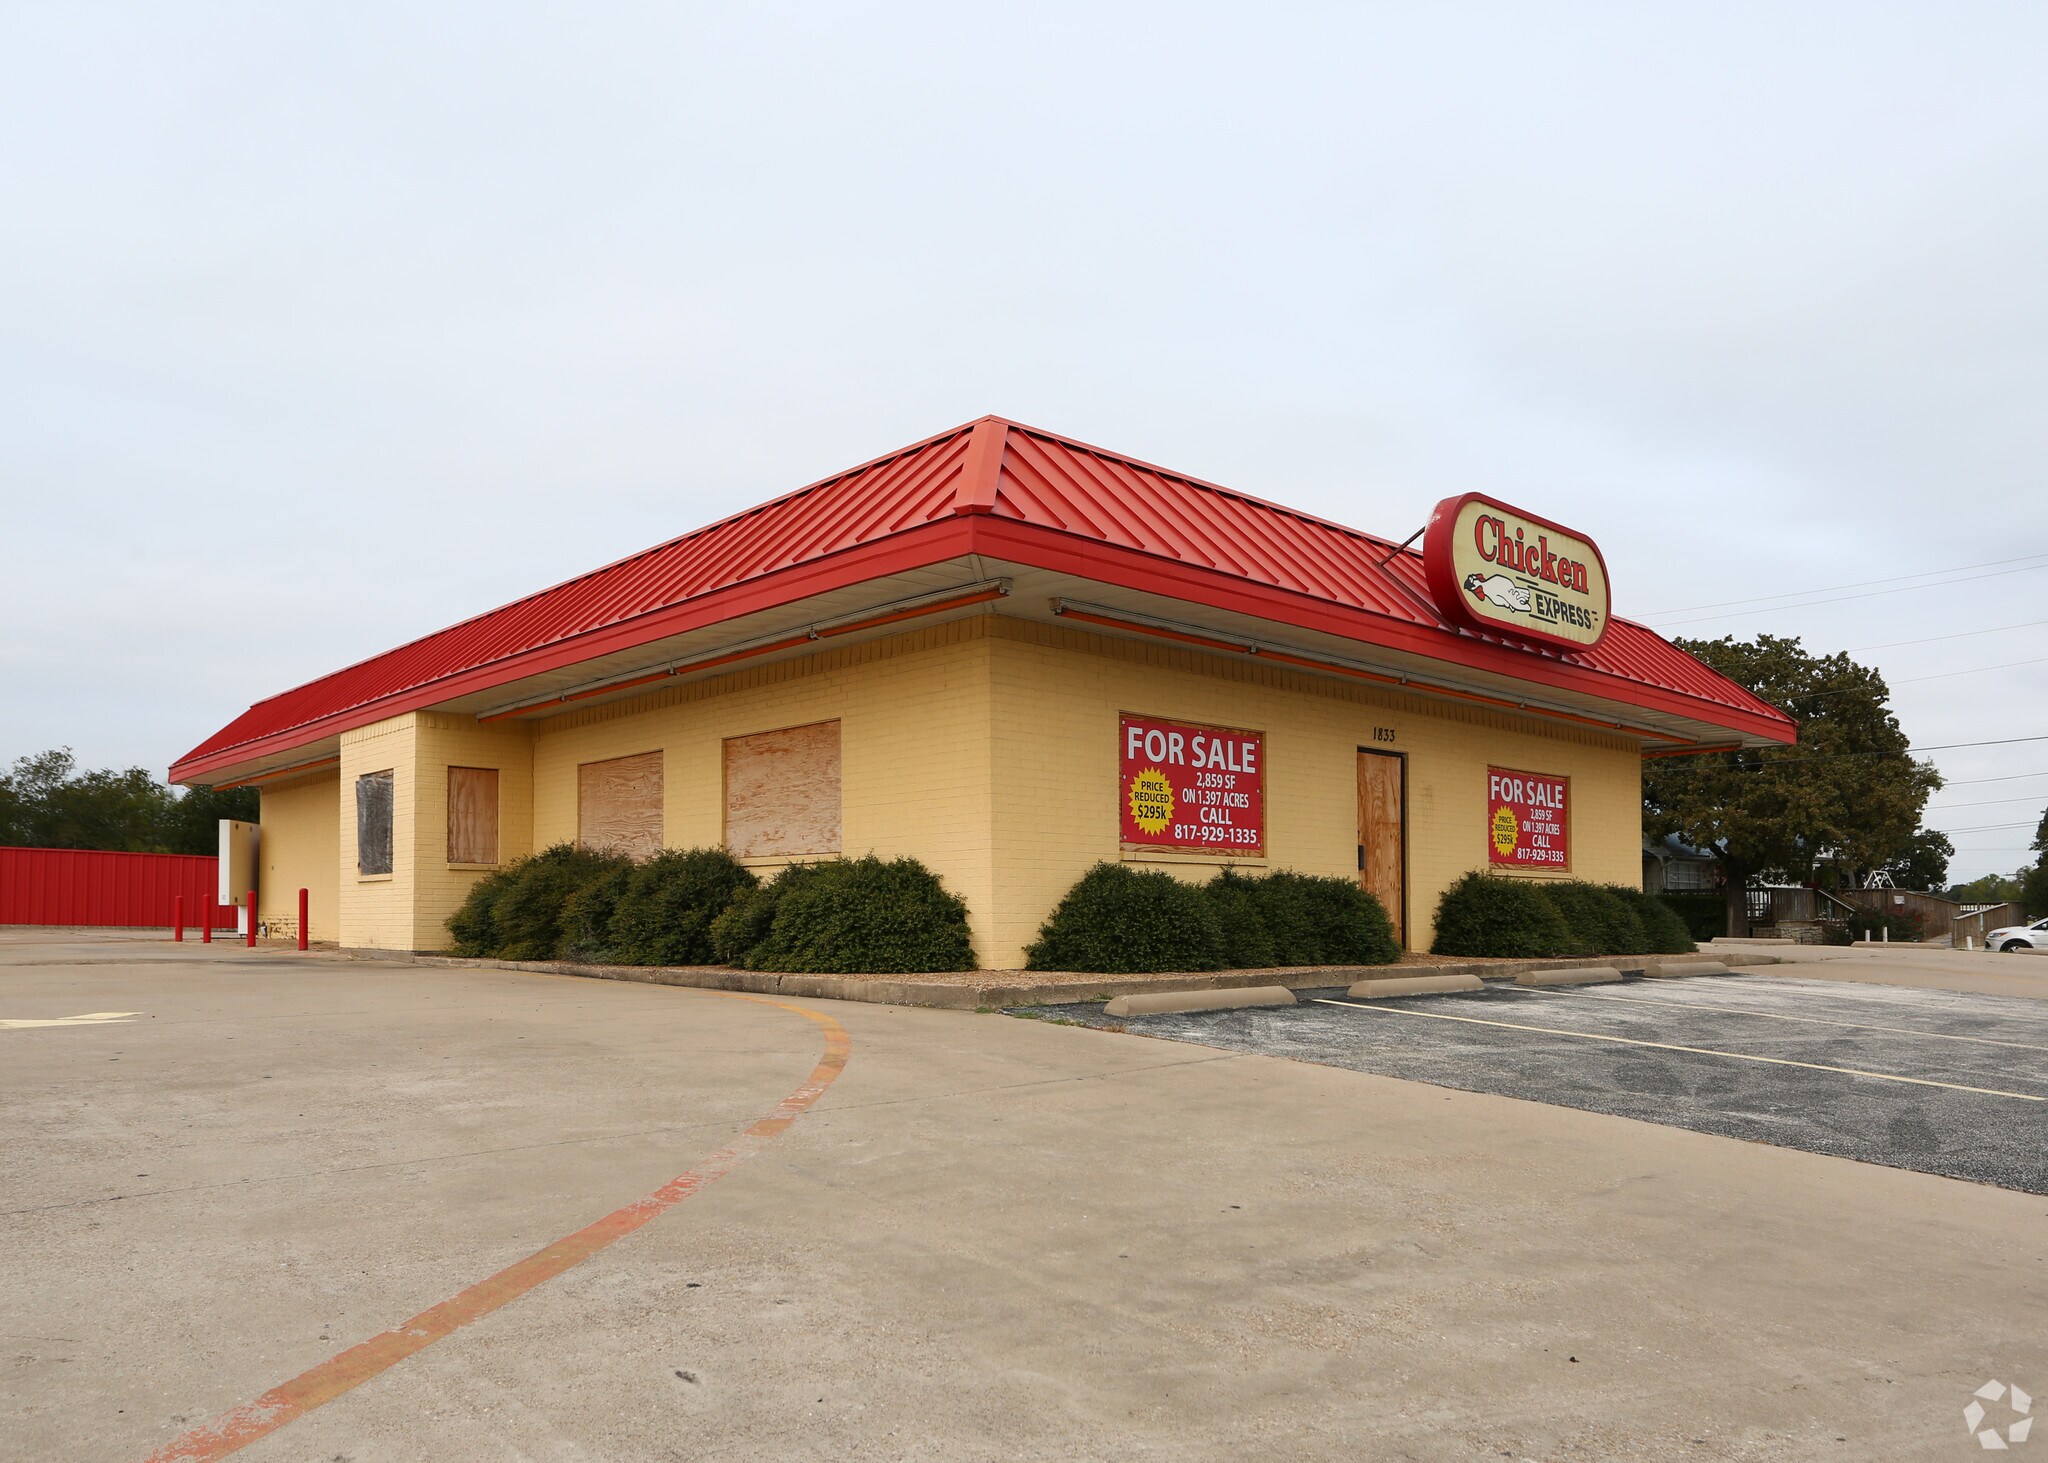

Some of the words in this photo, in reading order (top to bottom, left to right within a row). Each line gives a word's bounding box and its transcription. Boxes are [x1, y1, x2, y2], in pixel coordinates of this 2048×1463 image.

[1474, 514, 1589, 595] Chicken
[1535, 594, 1592, 630] EXPRESS
[1373, 726, 1395, 742] 1833
[1128, 726, 1184, 766] FOR
[1192, 736, 1256, 774] SALE
[1141, 780, 1163, 792] PRICE
[1196, 772, 1222, 788] 2,859
[1225, 774, 1236, 790] SF
[1134, 792, 1170, 804] REDUCED
[1182, 788, 1196, 804] ON
[1198, 790, 1221, 806] 1.397
[1223, 792, 1249, 808] ACRES
[1491, 776, 1524, 804] FOR
[1526, 780, 1563, 808] SALE
[1138, 804, 1166, 820] $295k
[1200, 806, 1232, 824] CALL
[1498, 816, 1512, 824] PRICE
[1530, 808, 1546, 821] 2,859
[1546, 810, 1552, 821] SF
[1174, 824, 1256, 844] 817-929-1335
[1494, 824, 1516, 832] REDUCED
[1522, 820, 1530, 832] ON
[1532, 822, 1544, 834] 1.397
[1546, 823, 1560, 835] ACRES
[1532, 834, 1550, 848] CALL
[1518, 848, 1564, 862] 817-929-1335
